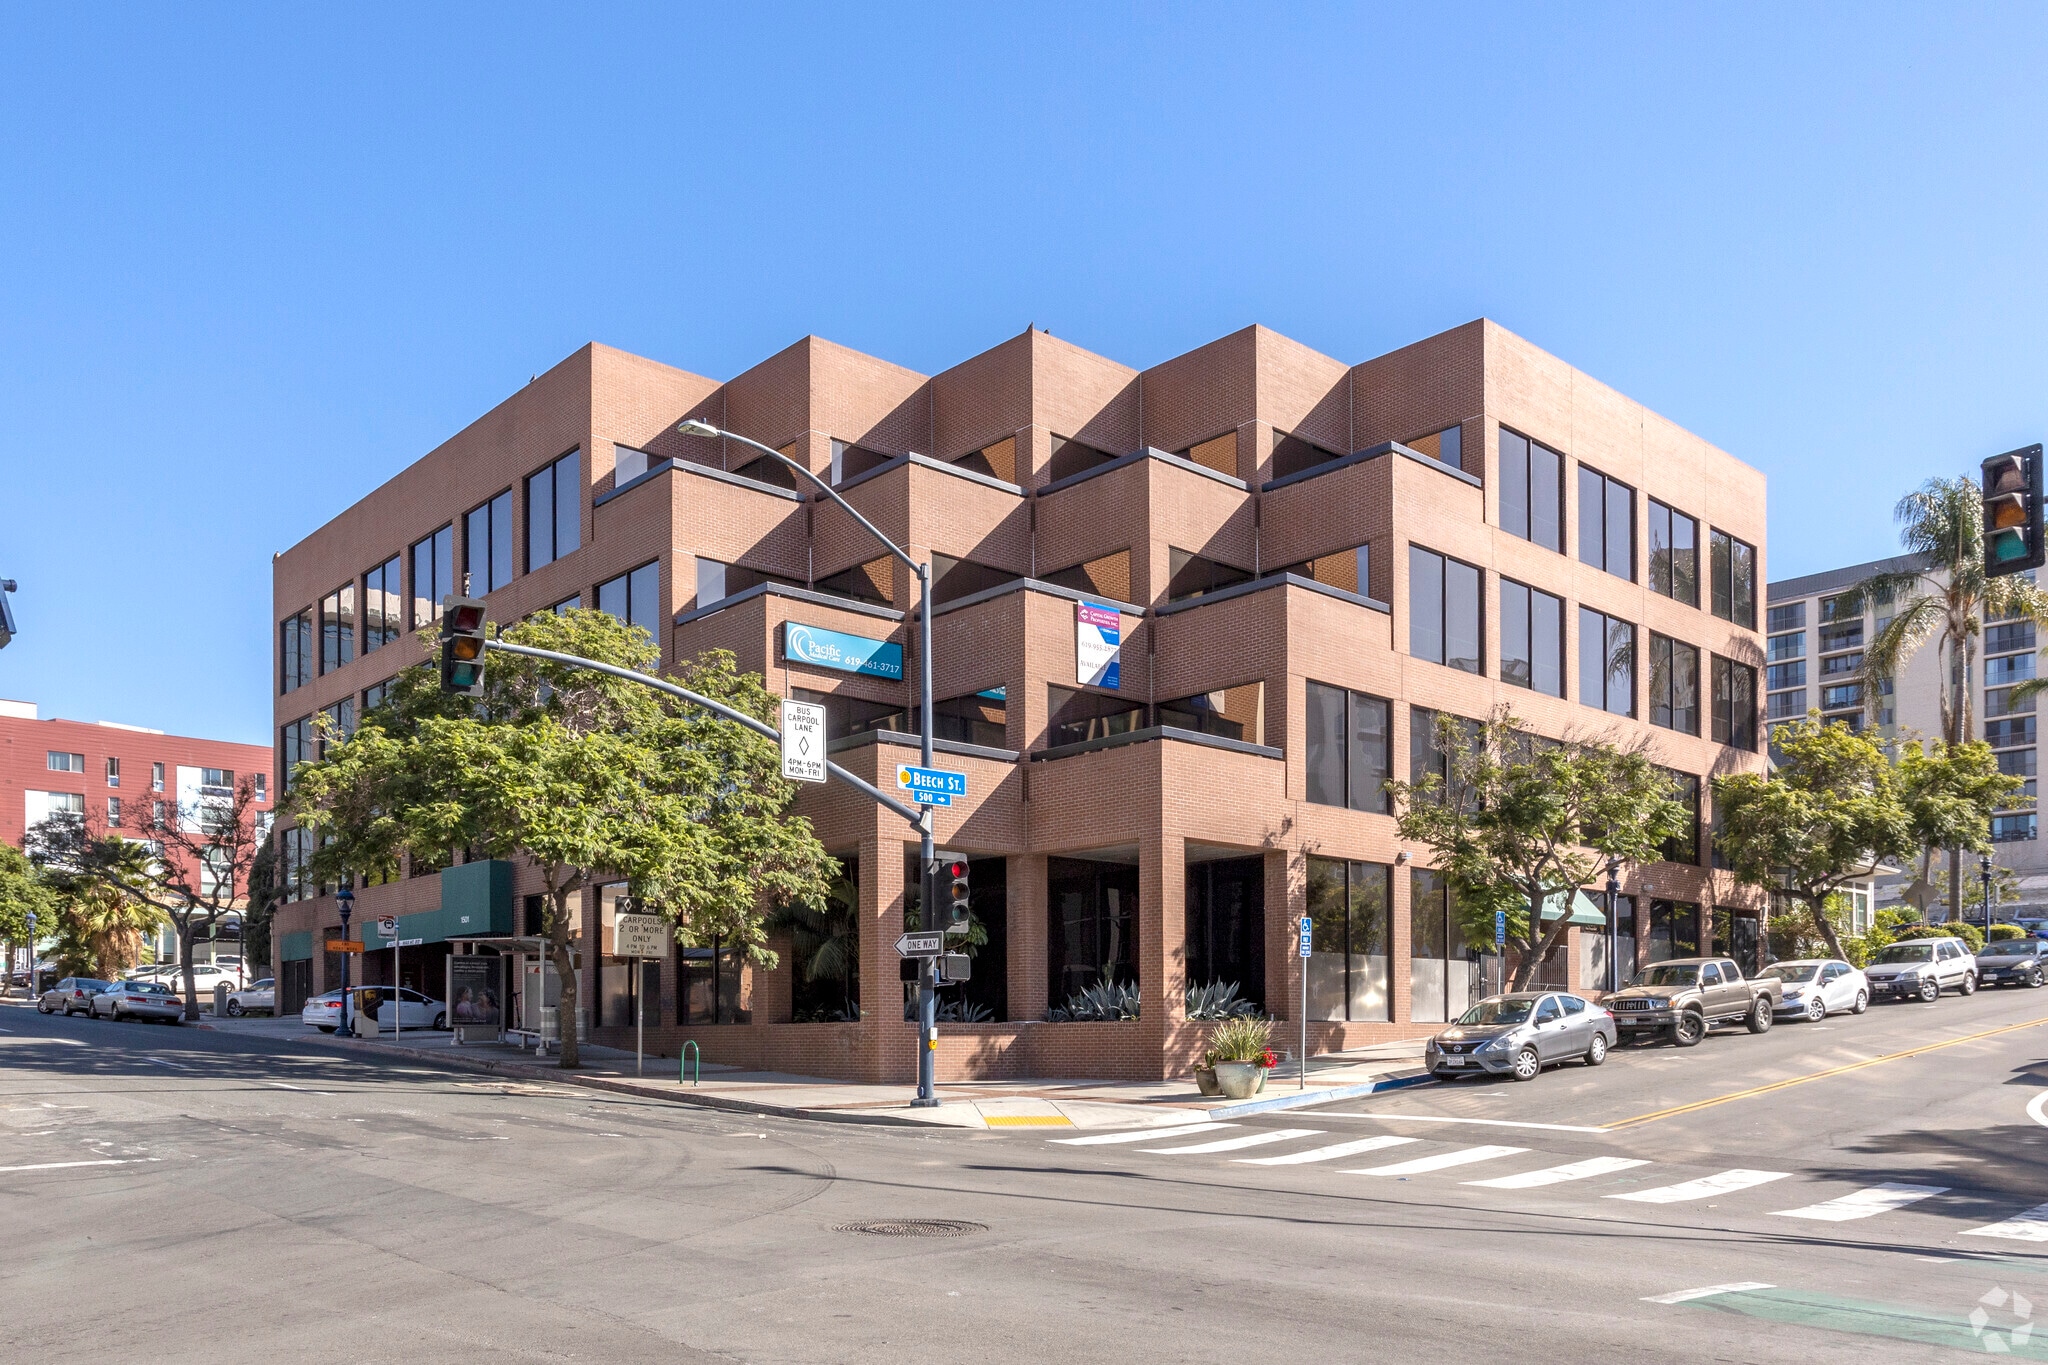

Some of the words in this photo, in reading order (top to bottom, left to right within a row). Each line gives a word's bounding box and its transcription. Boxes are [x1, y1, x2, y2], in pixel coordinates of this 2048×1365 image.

[808, 641, 841, 656] Pacific
[809, 651, 828, 659] Medical
[844, 656, 900, 673] 619-461-3717
[796, 706, 811, 715] BUS
[787, 713, 820, 725] CARPOOL
[794, 723, 813, 732] LANE
[913, 771, 944, 788] BEECH
[947, 776, 962, 791] ST.
[918, 791, 933, 802] 500
[622, 916, 662, 925] CARPOOLS
[619, 924, 625, 932] 2
[643, 926, 664, 934] MORE
[907, 940, 921, 949] ONE
[922, 939, 938, 948] WAY
